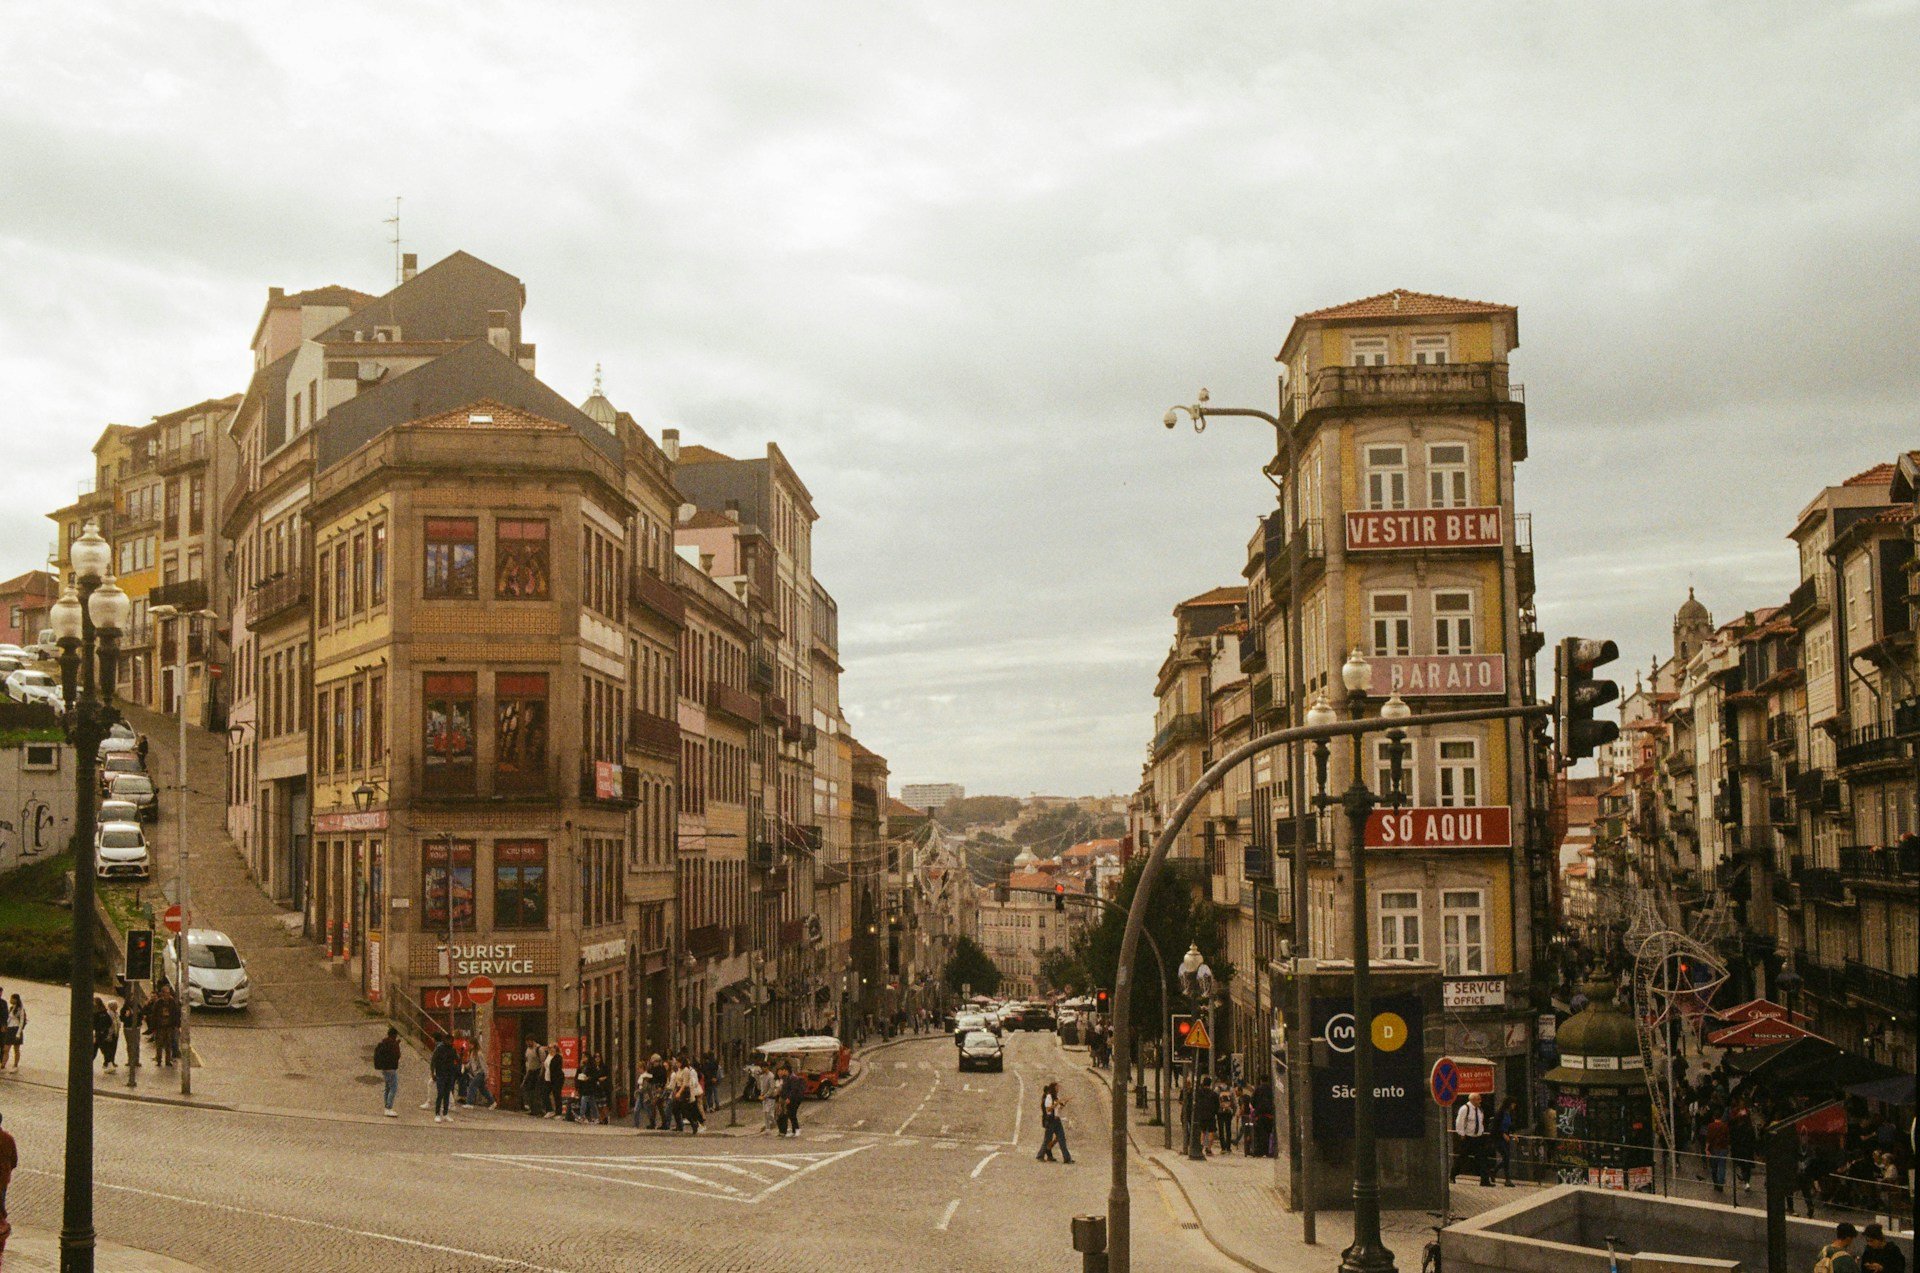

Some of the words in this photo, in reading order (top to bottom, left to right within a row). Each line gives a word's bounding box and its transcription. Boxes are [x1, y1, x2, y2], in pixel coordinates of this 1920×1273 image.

[1349, 516, 1437, 544] VESTIR
[1446, 513, 1498, 541] BEM
[1391, 661, 1492, 690] BARATO
[1381, 810, 1413, 842] SÓ
[1424, 813, 1483, 842] AQUI
[458, 960, 534, 975] SERVICE
[1455, 981, 1502, 994] SERVICE
[506, 993, 536, 1001] TOURS
[1453, 997, 1486, 1005] OFFICE
[1383, 1026, 1394, 1039] D
[1373, 1086, 1405, 1098] ento
